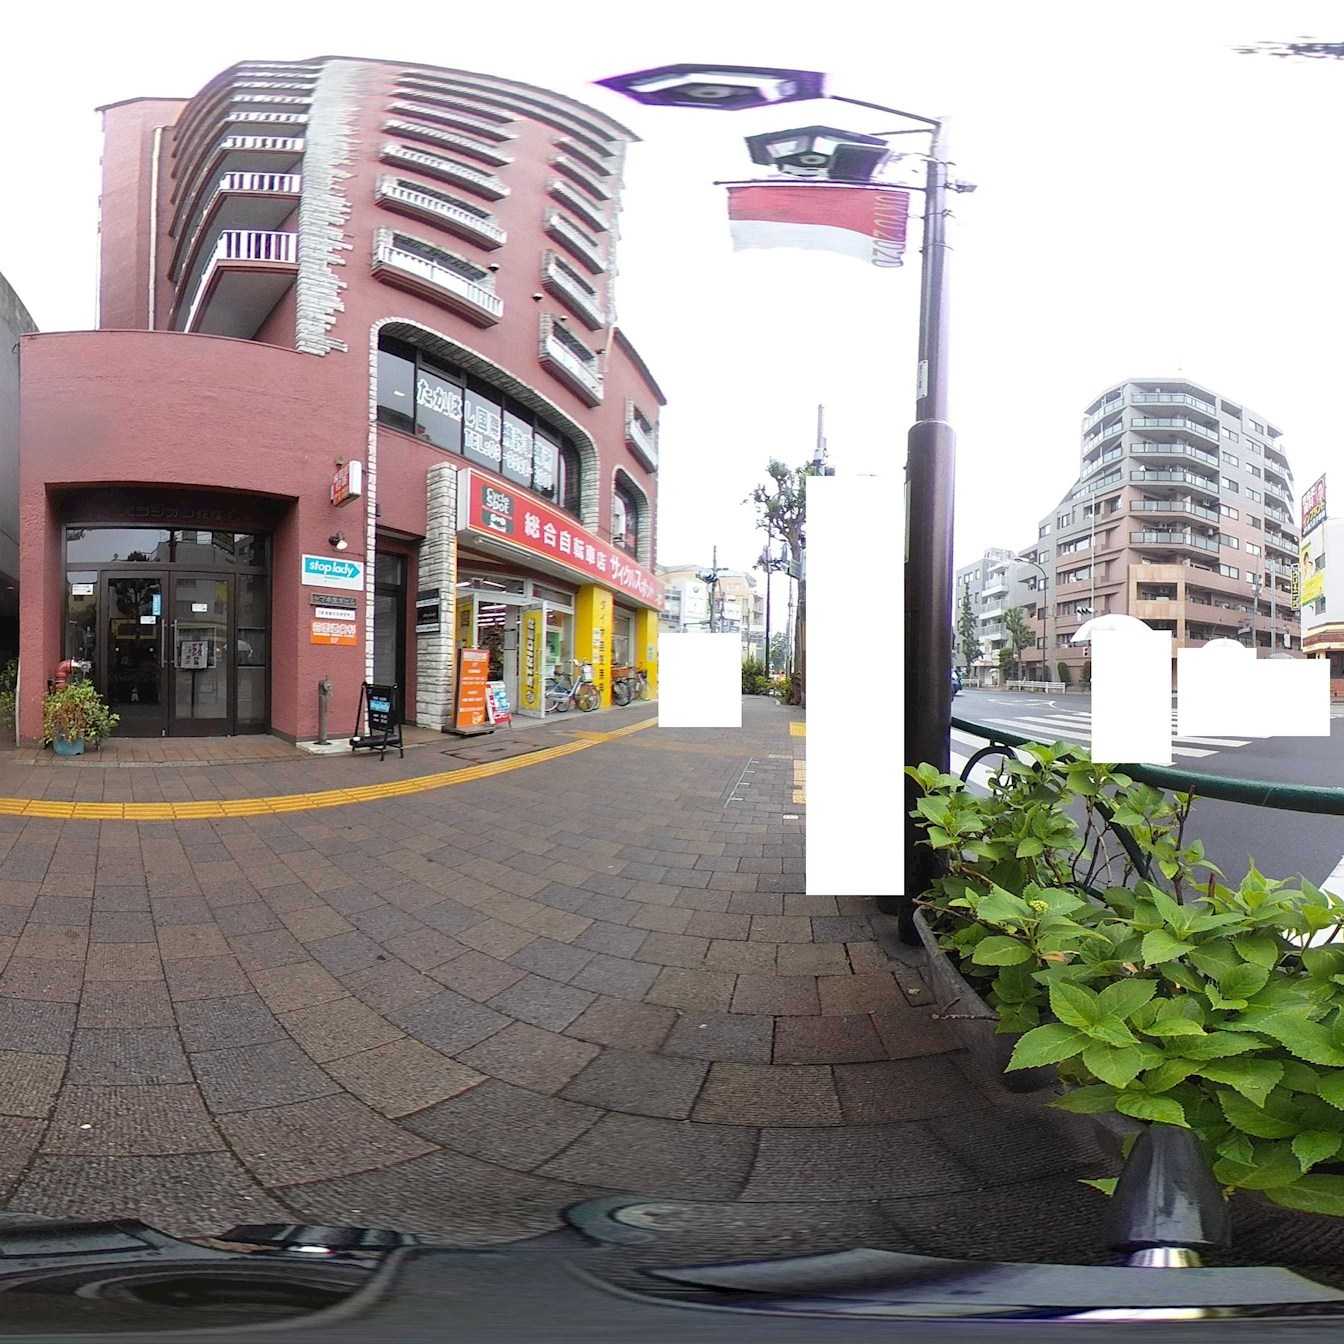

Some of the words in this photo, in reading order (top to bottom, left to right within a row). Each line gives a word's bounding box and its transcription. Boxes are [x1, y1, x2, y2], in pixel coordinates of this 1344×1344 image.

[486, 487, 510, 504] Cycle
[486, 499, 510, 514] Spot
[523, 512, 607, 572] 総合自転車店
